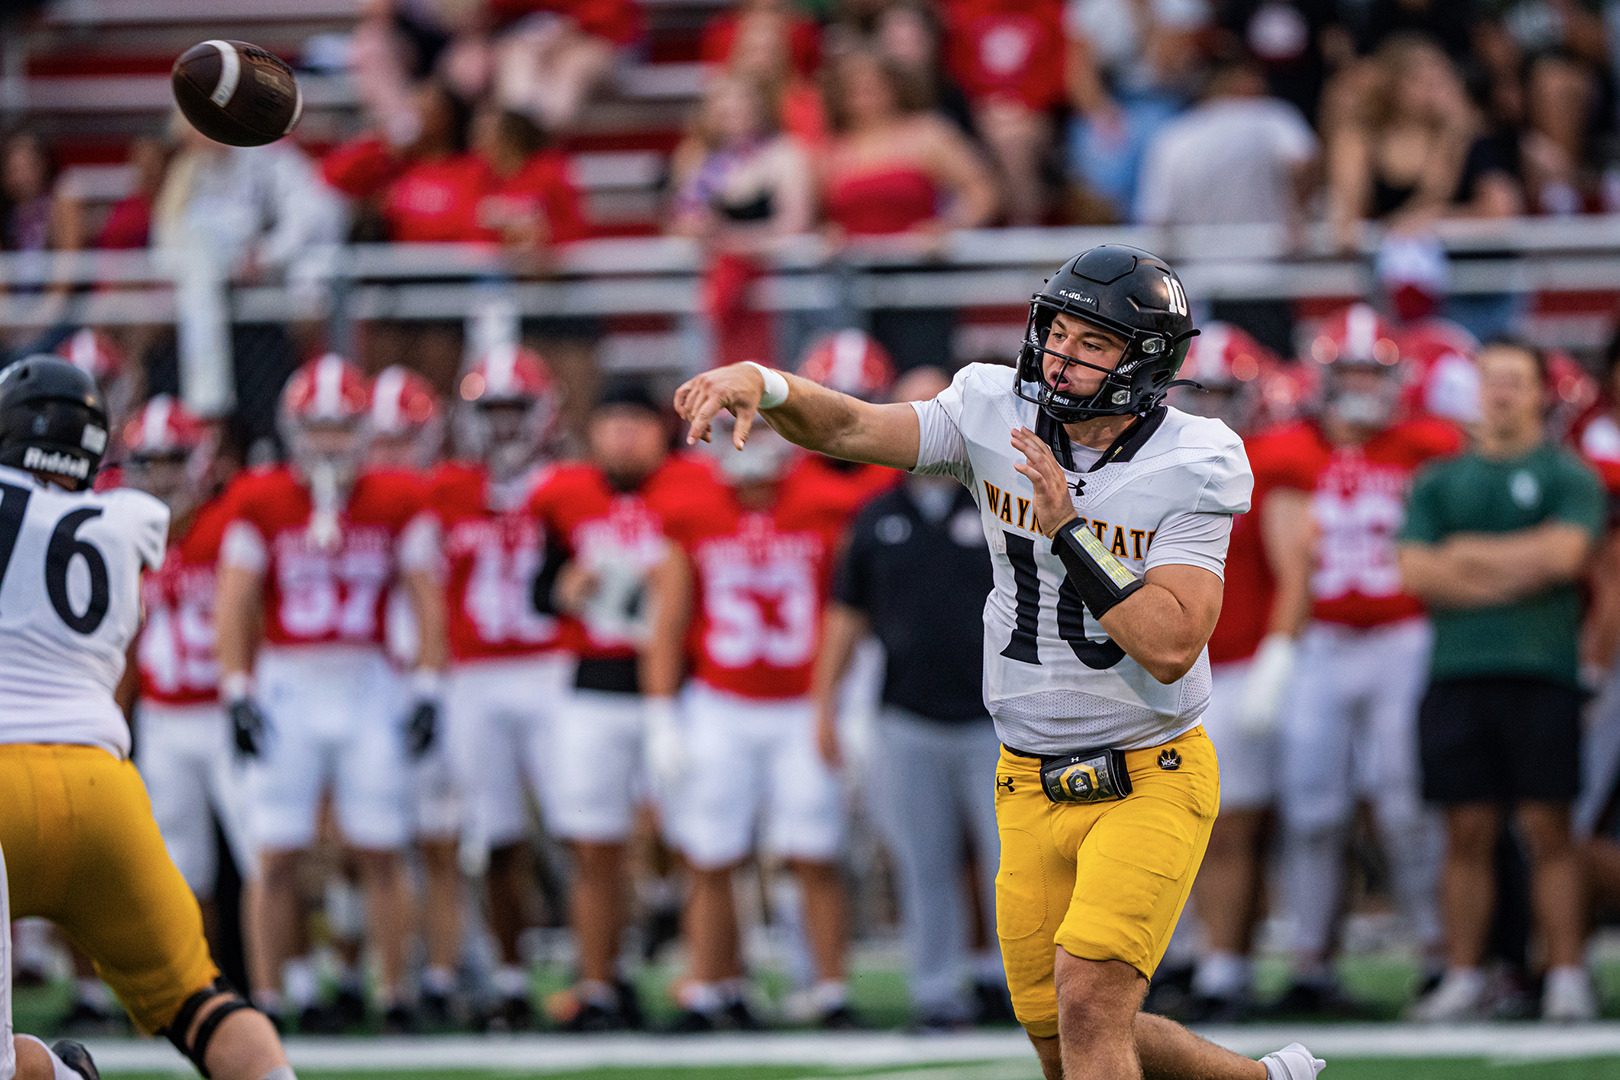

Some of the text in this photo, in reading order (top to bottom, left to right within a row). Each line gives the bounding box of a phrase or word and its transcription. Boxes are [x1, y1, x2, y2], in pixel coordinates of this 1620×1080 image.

[1162, 275, 1188, 317] 10
[1045, 390, 1070, 406] Rddell
[23, 447, 90, 480] Riddell
[983, 479, 1045, 537] WAYN
[1081, 516, 1157, 561] TAT
